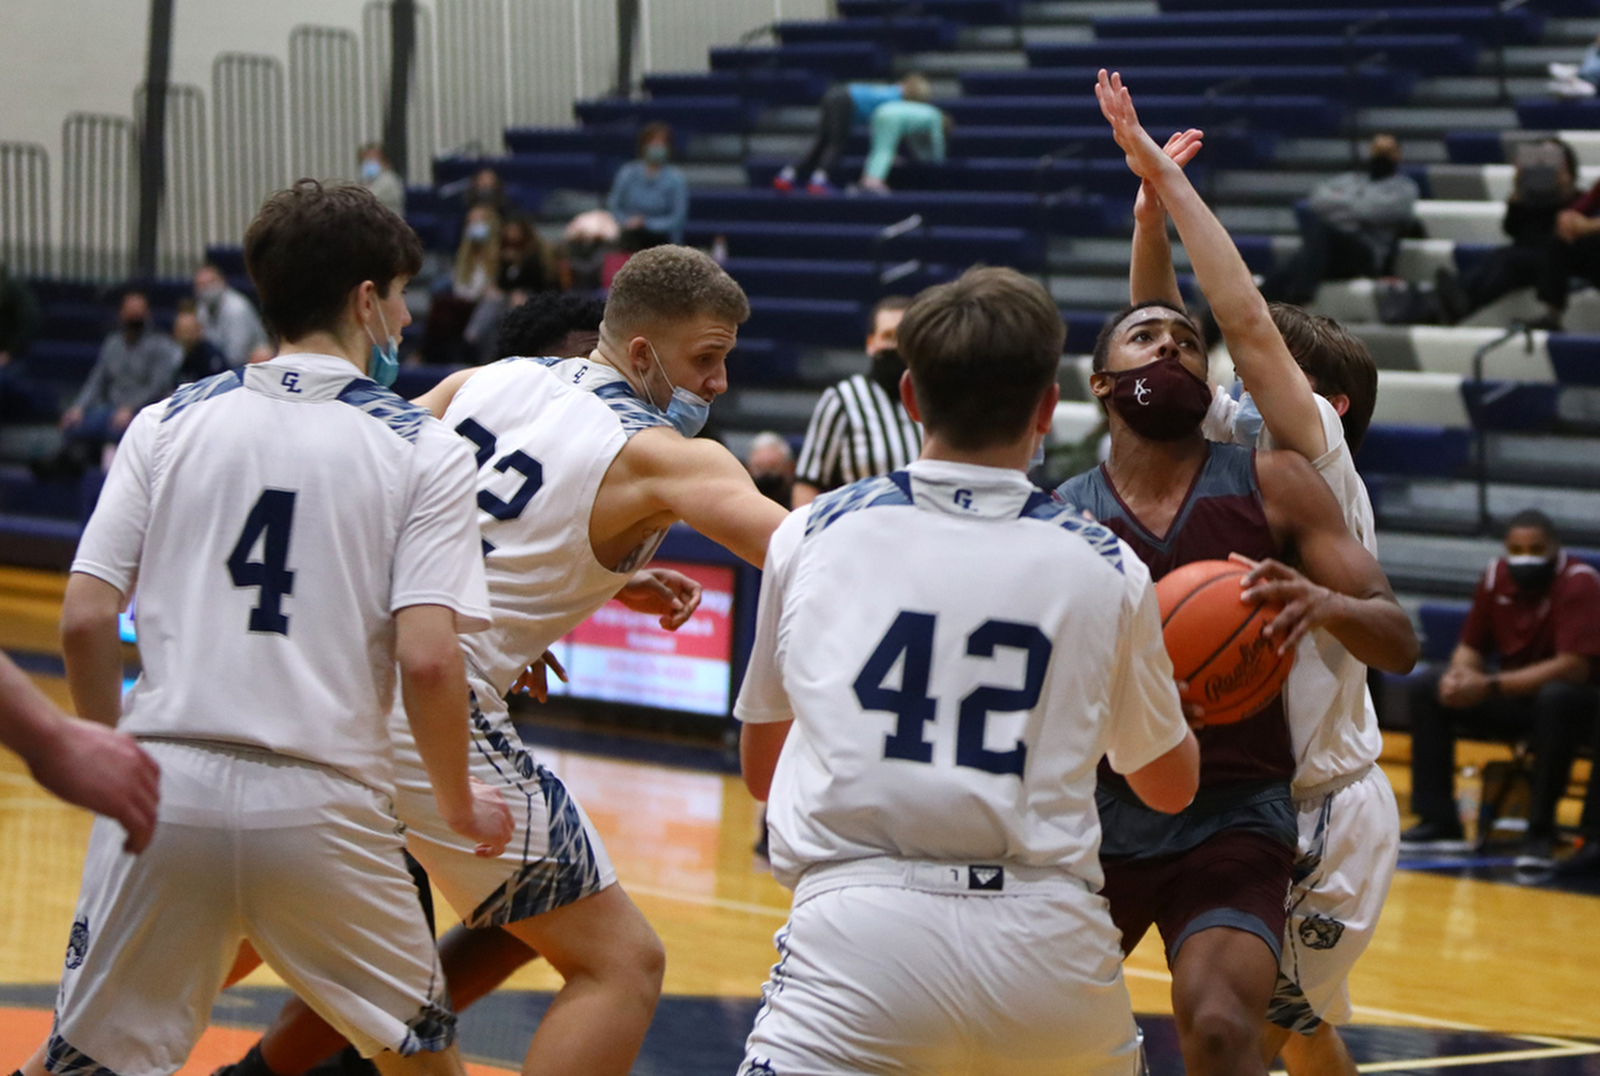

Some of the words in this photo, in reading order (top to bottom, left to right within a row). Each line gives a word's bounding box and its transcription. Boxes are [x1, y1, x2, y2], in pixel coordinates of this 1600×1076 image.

[281, 371, 303, 394] GL
[1133, 378, 1152, 406] KC
[227, 488, 299, 636] 4
[852, 610, 1053, 778] 42
[1205, 619, 1275, 702] Rawling
